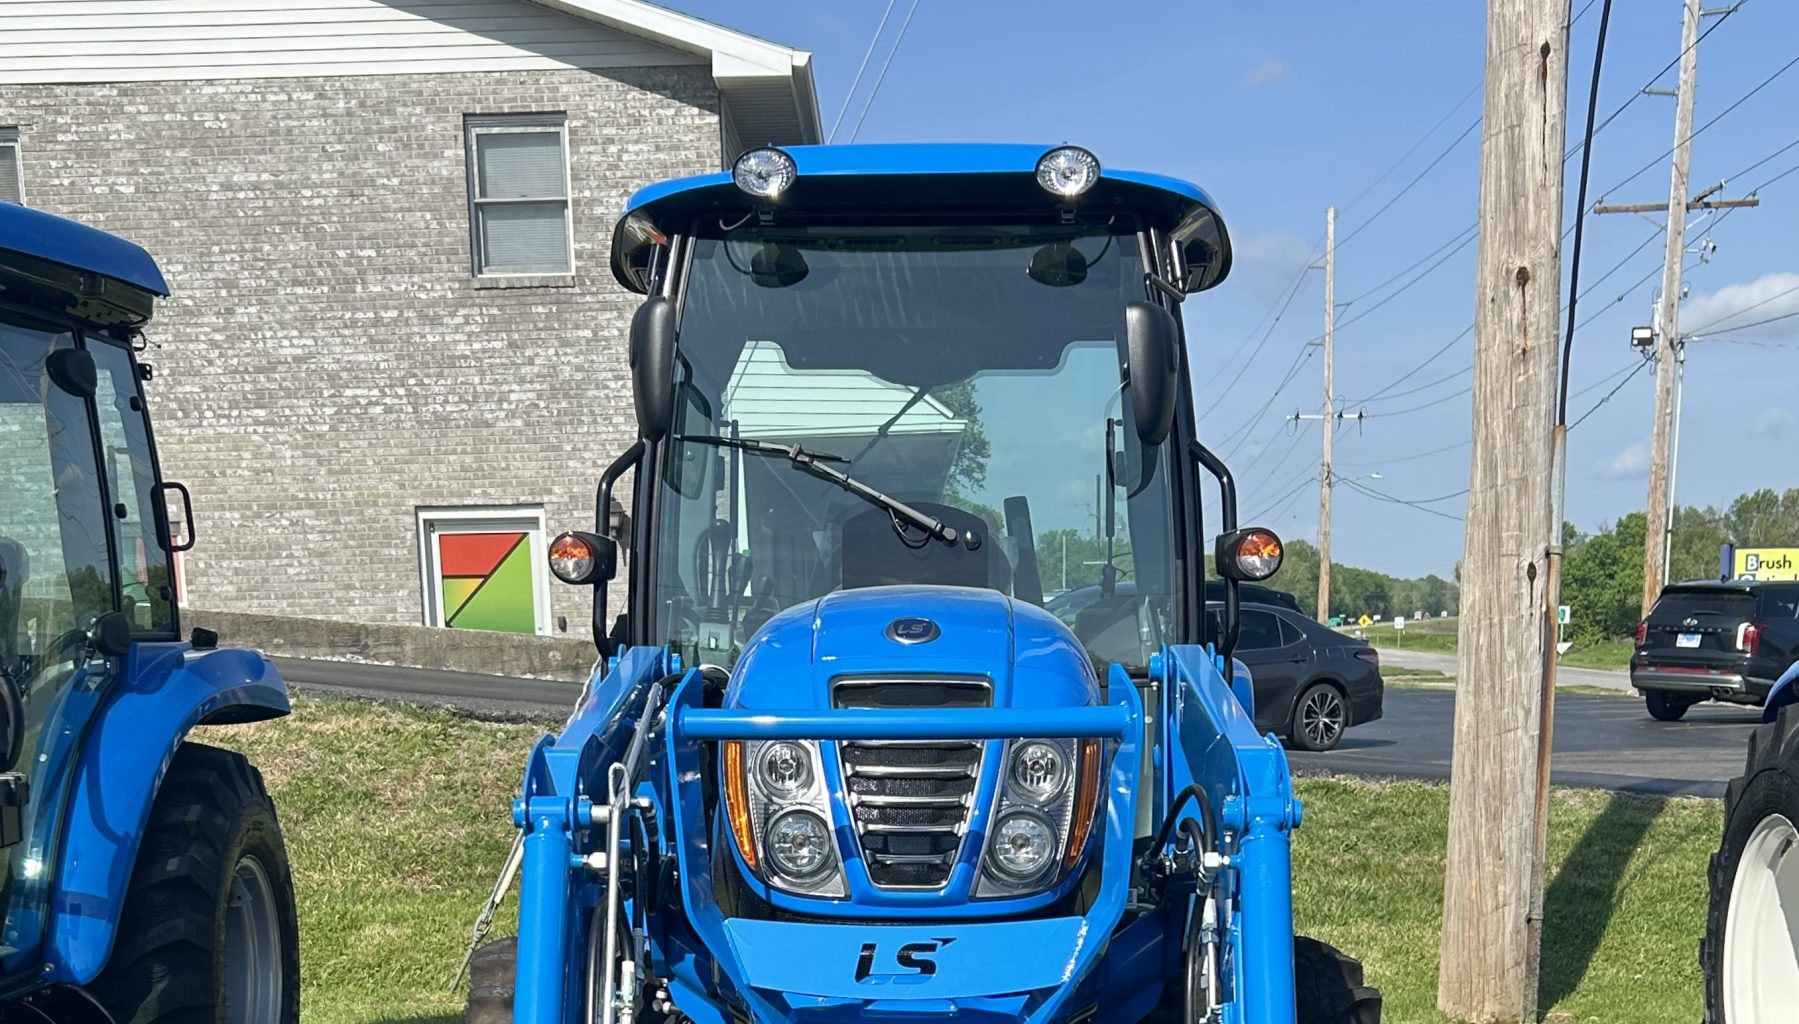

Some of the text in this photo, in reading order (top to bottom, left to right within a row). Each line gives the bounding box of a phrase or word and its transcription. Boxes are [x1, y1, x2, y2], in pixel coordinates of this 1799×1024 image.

[1747, 554, 1792, 570] Brush
[897, 623, 927, 634] LS
[855, 938, 957, 985] LS
